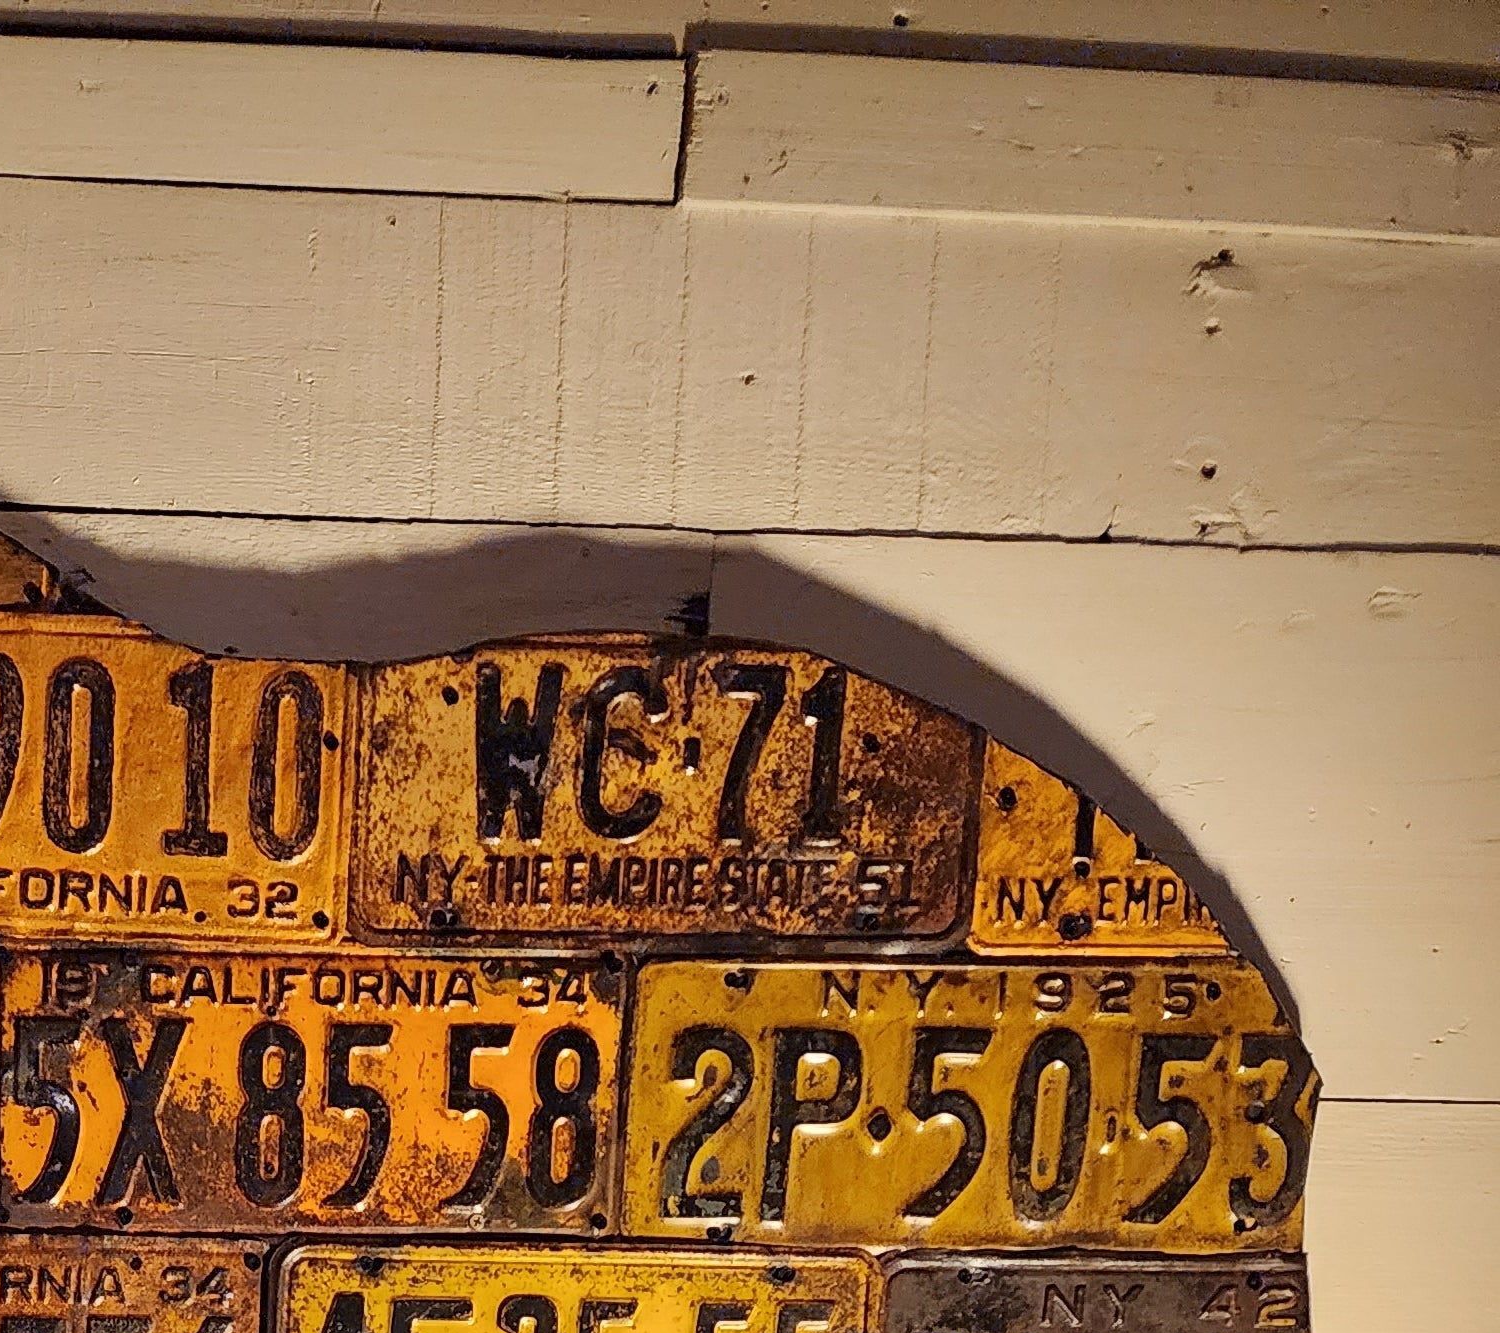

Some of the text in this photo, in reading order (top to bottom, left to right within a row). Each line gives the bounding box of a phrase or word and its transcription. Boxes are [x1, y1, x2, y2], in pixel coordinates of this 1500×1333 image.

[225, 882, 300, 922] 32
[564, 855, 707, 908] EMPIRE
[995, 876, 1063, 926] NY
[140, 963, 478, 1010] CALIFORNIA
[516, 971, 590, 1010] 34
[1199, 1284, 1301, 1329] 42
